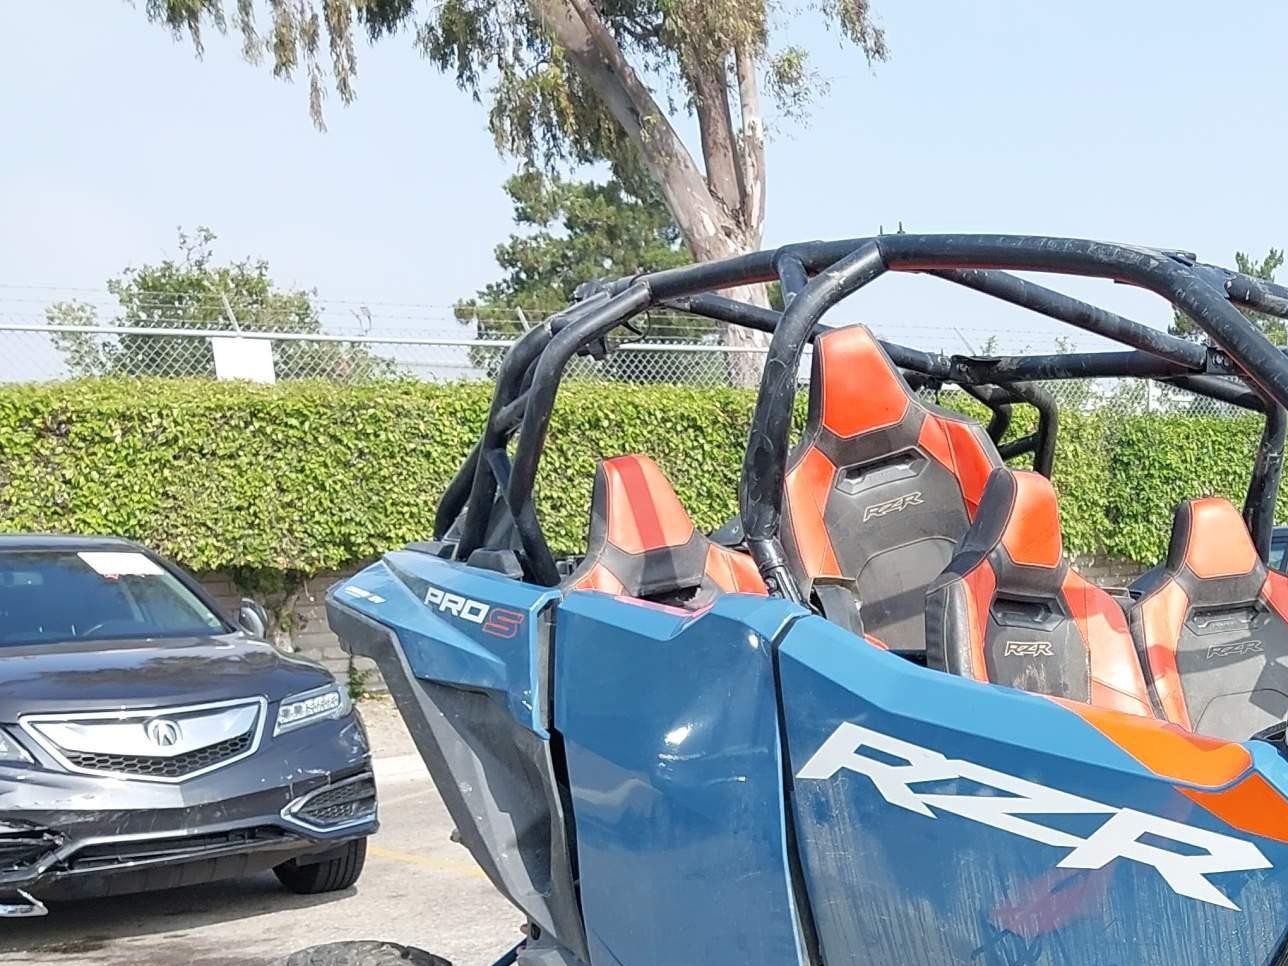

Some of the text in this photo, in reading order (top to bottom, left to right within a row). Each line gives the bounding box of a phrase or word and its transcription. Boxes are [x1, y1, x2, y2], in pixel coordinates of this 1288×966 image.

[863, 491, 924, 521] RZR
[1004, 641, 1055, 656] RZR
[1207, 640, 1264, 659] RZR
[796, 721, 1273, 911] RZR
